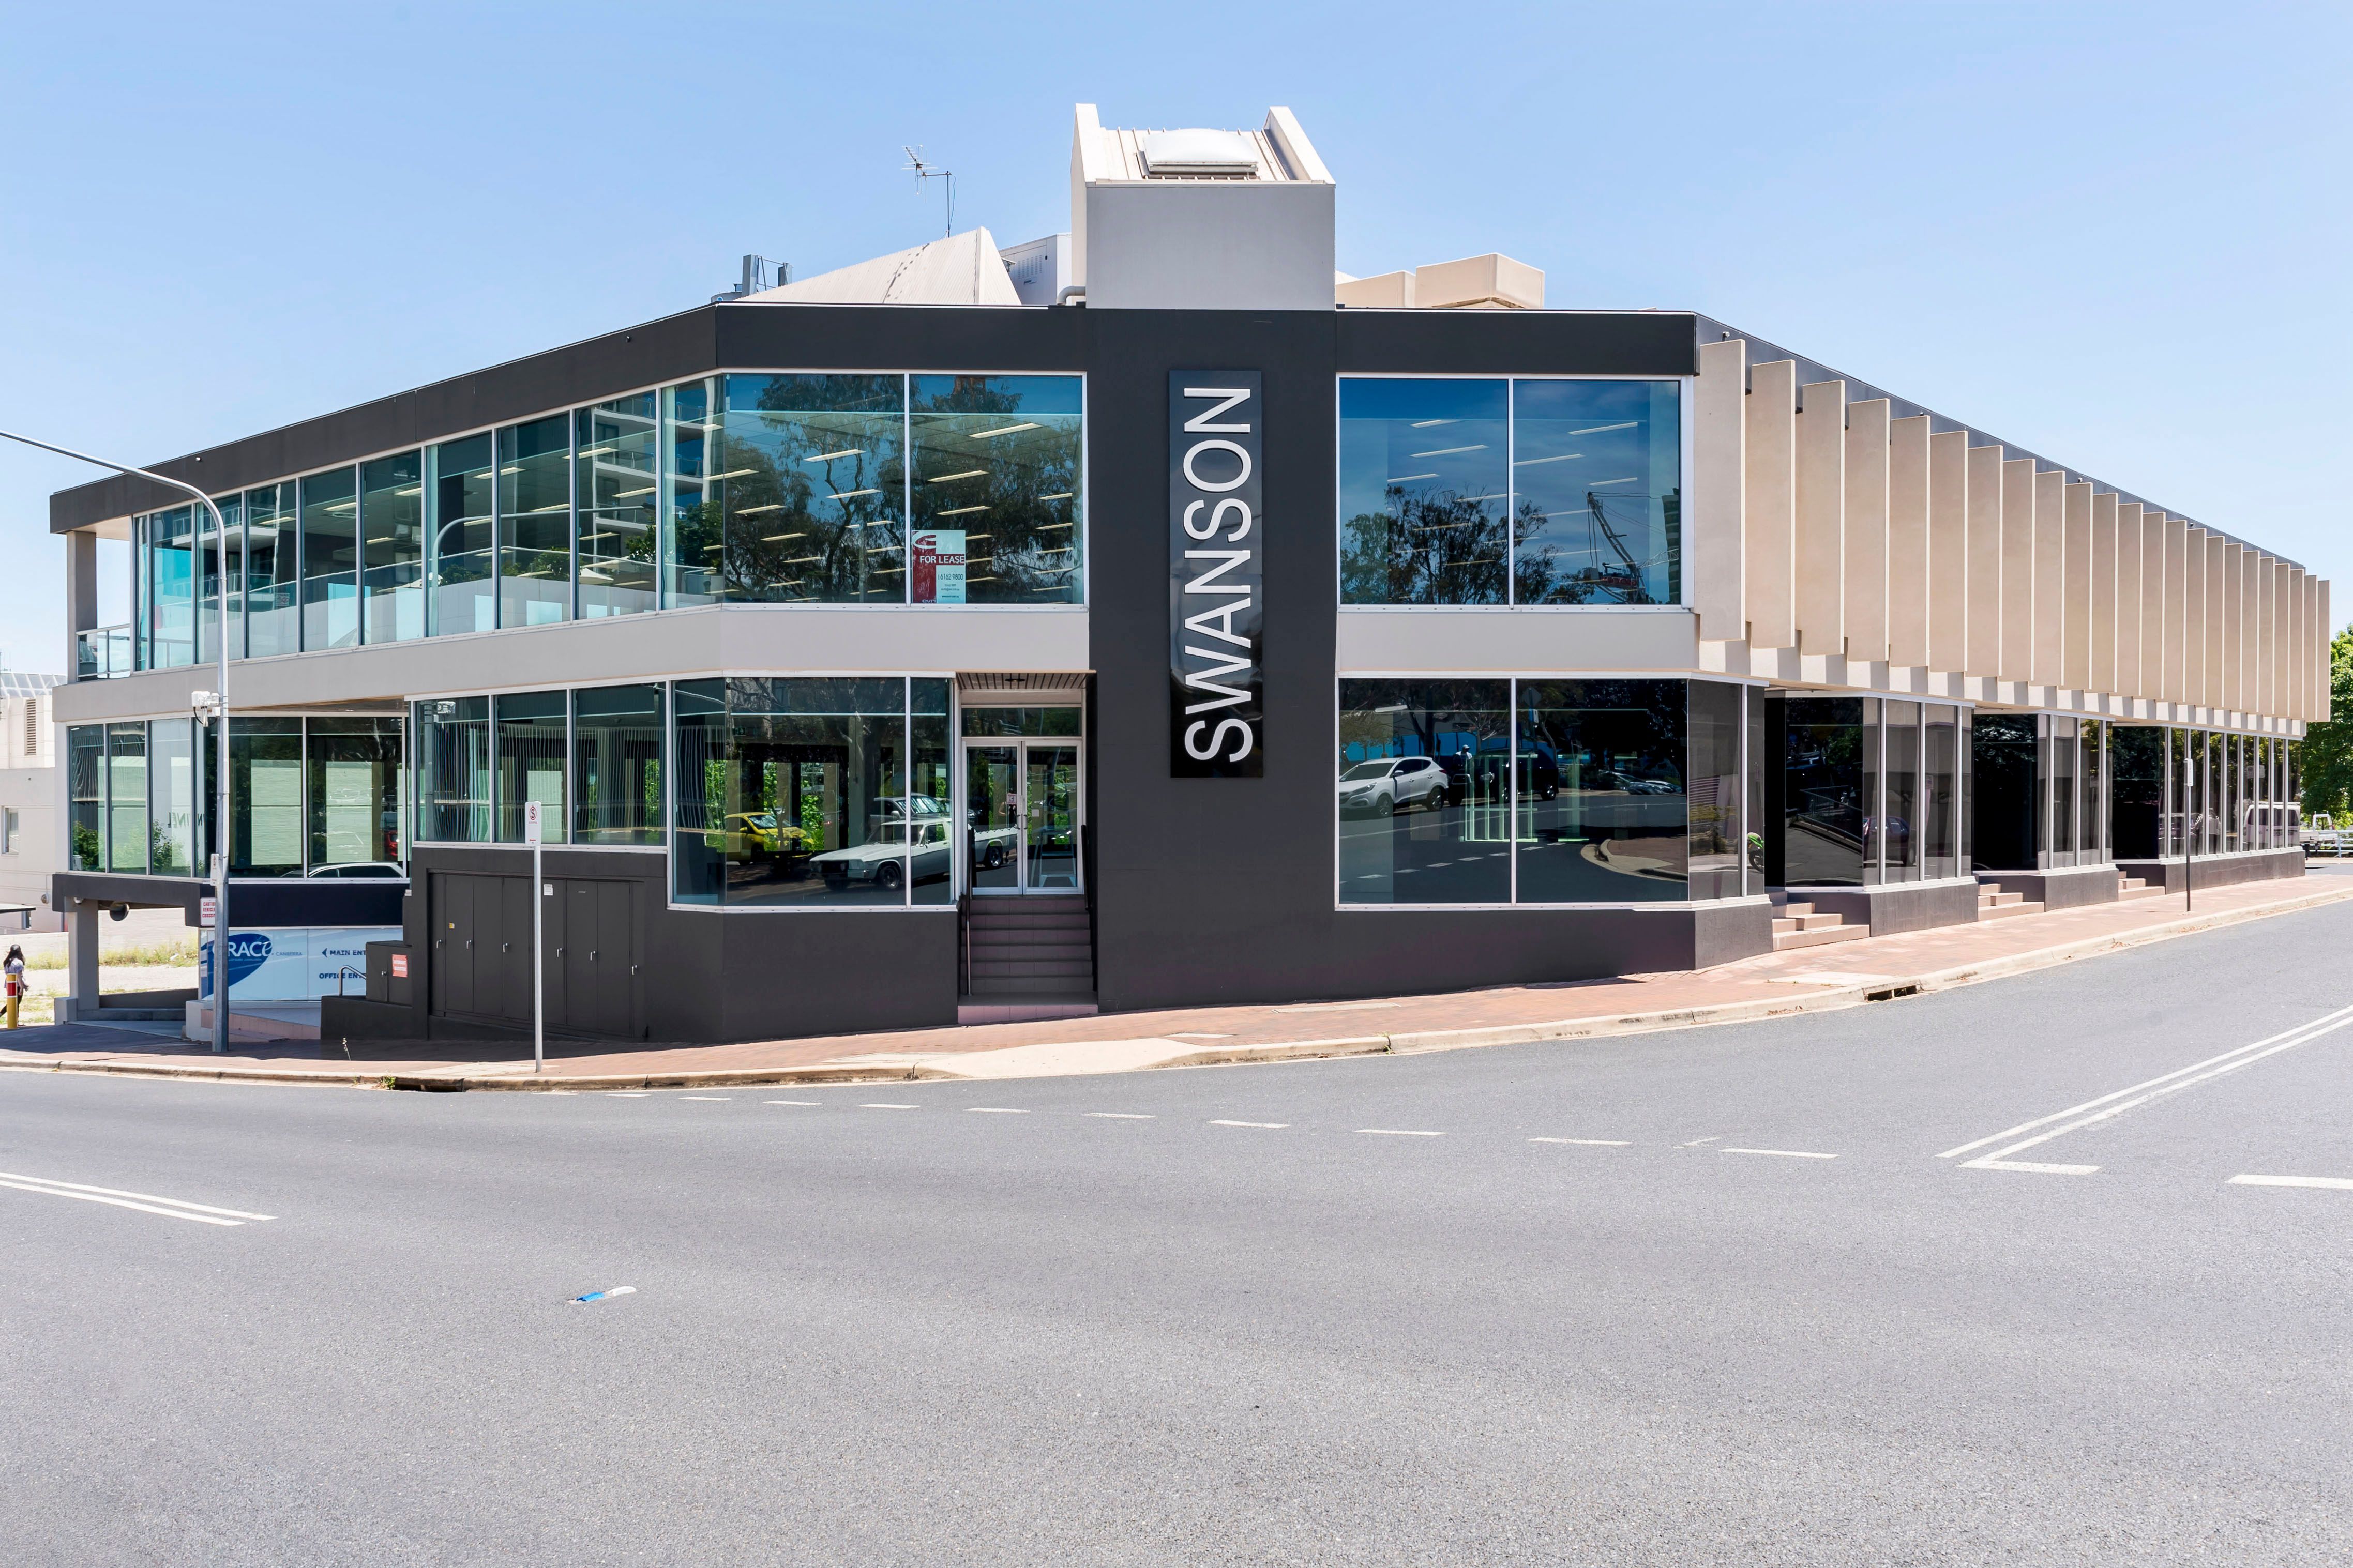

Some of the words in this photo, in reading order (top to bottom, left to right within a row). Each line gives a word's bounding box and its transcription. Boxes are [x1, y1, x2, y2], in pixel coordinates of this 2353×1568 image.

[919, 555, 937, 564] FOR
[939, 555, 964, 564] LEASE
[1183, 388, 1253, 763] SWANSON
